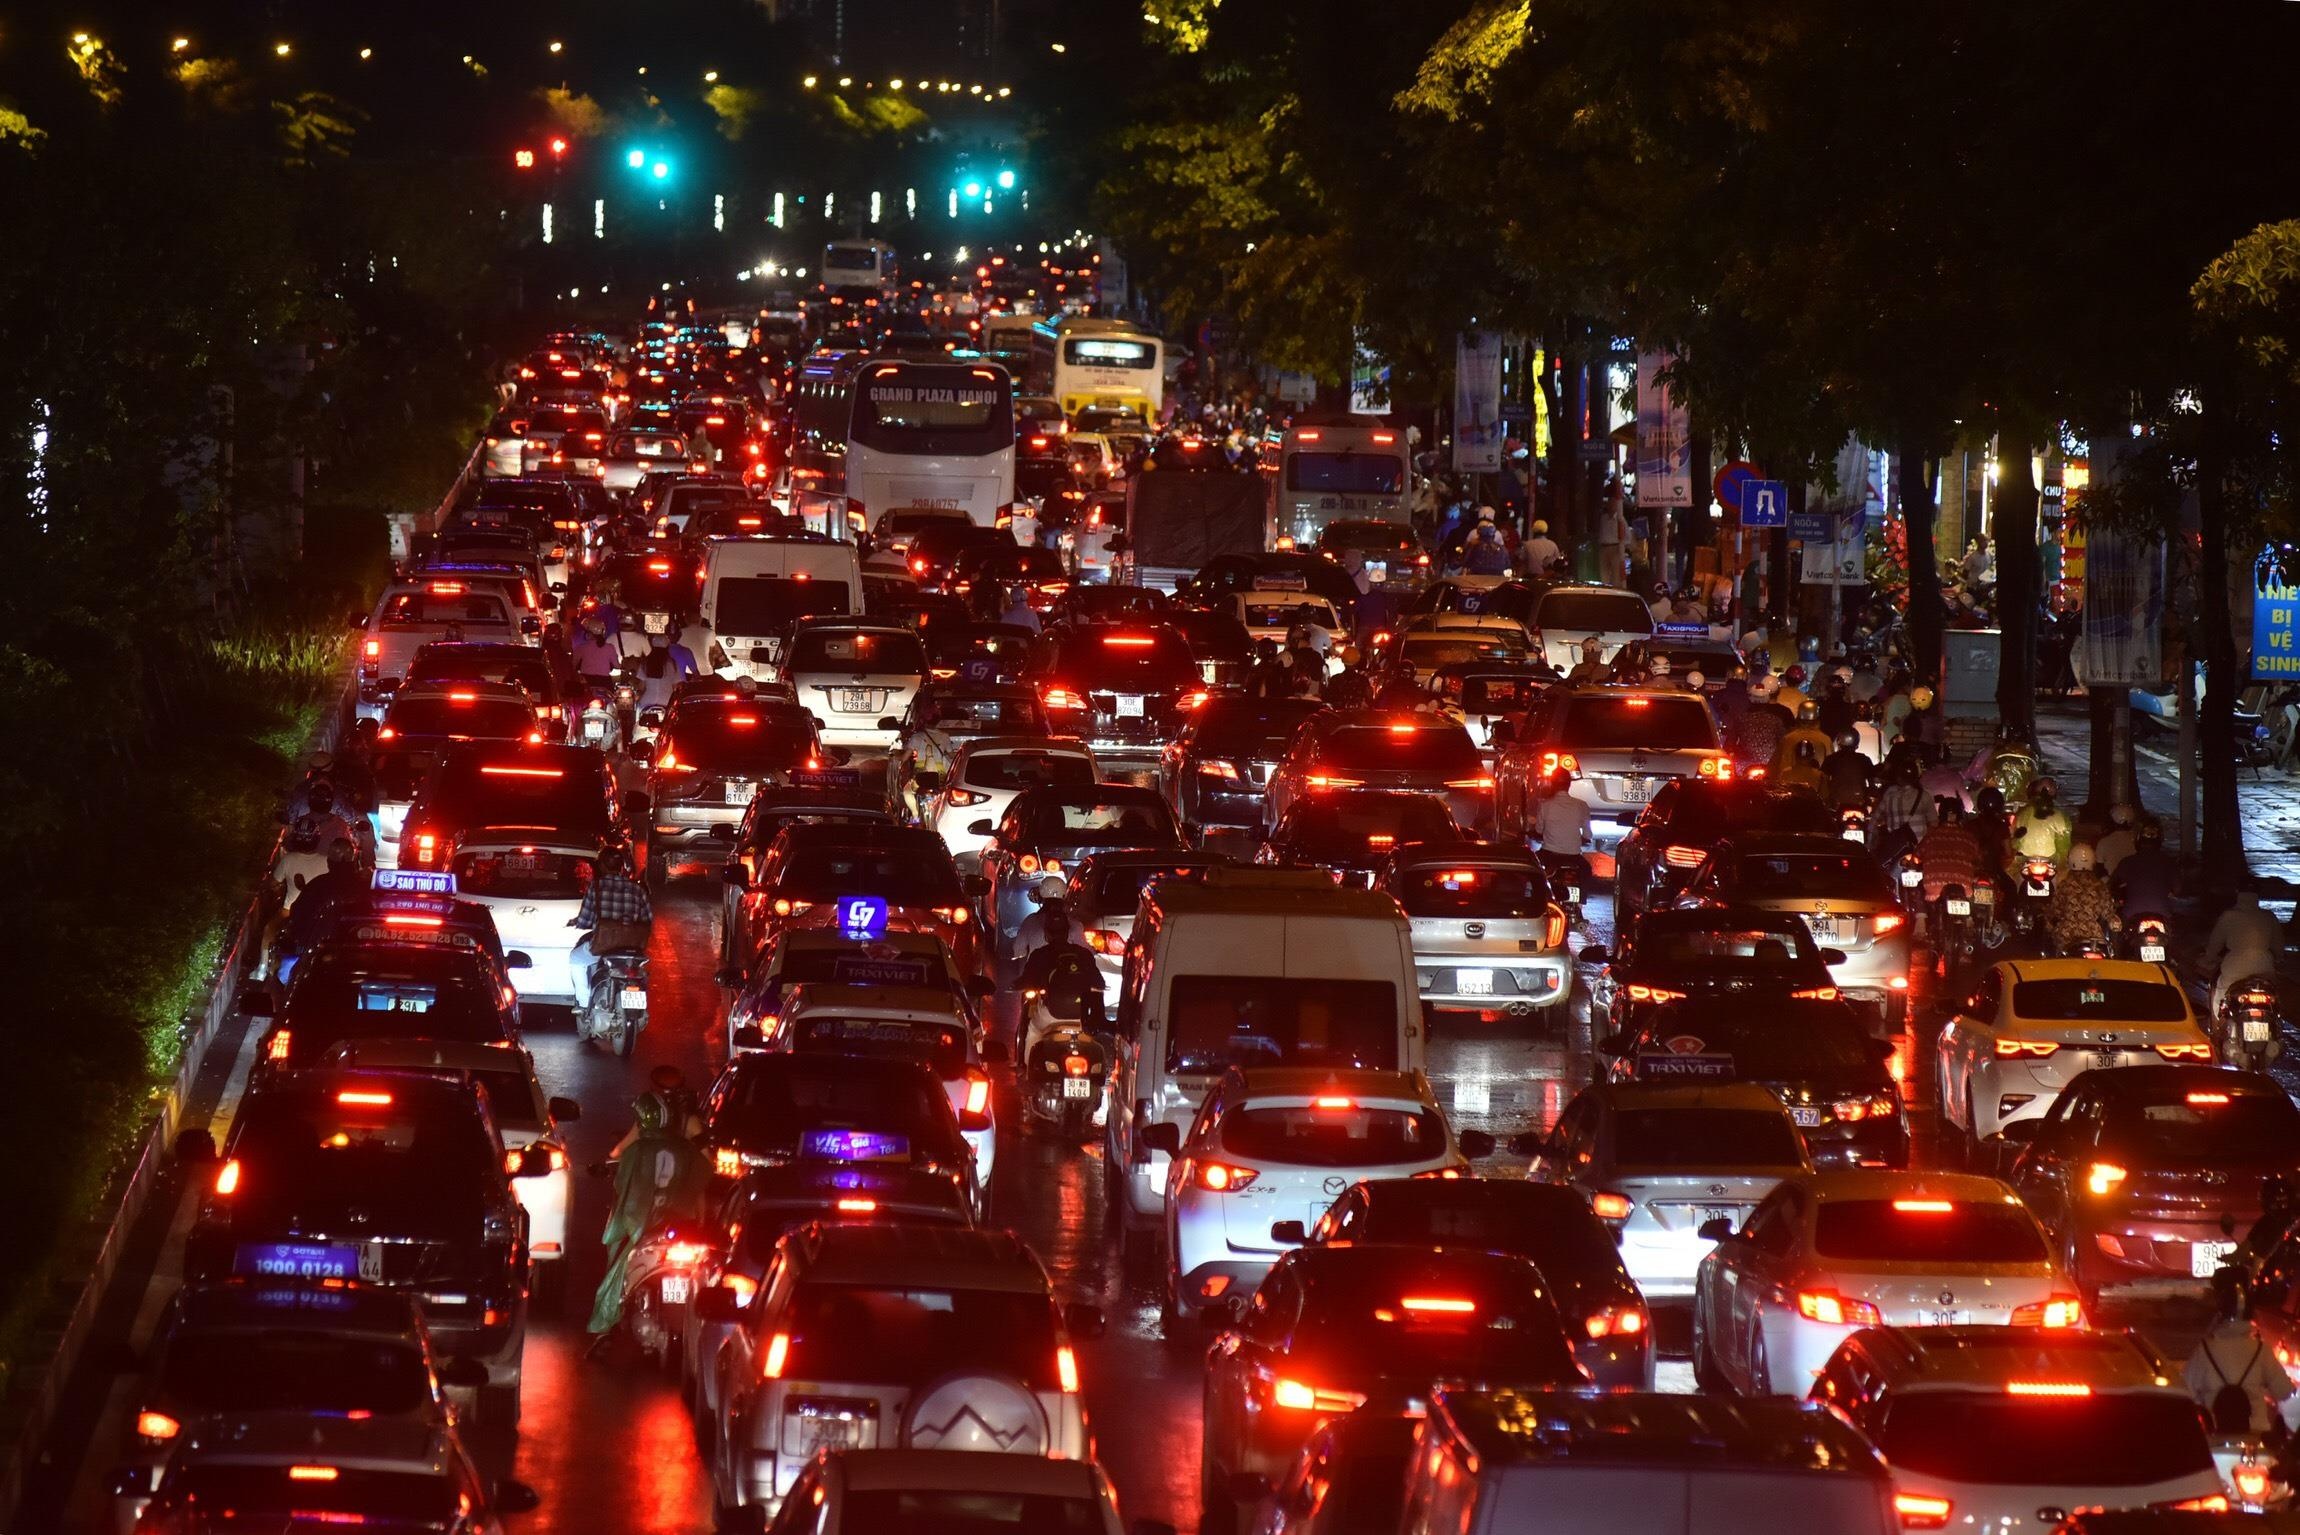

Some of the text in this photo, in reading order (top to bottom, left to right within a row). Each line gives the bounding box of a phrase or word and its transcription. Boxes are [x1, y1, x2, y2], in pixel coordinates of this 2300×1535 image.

[870, 387, 998, 405] GRAND PLAZA HANOI
[1807, 570, 1859, 580] Vietcobank
[2271, 609, 2292, 627] BỊ
[2269, 630, 2292, 651] VỆ
[971, 662, 989, 680] G7
[2256, 656, 2300, 672] SINH
[850, 693, 865, 702] 29A
[733, 783, 749, 794] 30F
[1630, 782, 1645, 791] 30E
[397, 877, 414, 890] SAO
[1811, 920, 1830, 931] 89A
[256, 1260, 344, 1277] 1900.0128
